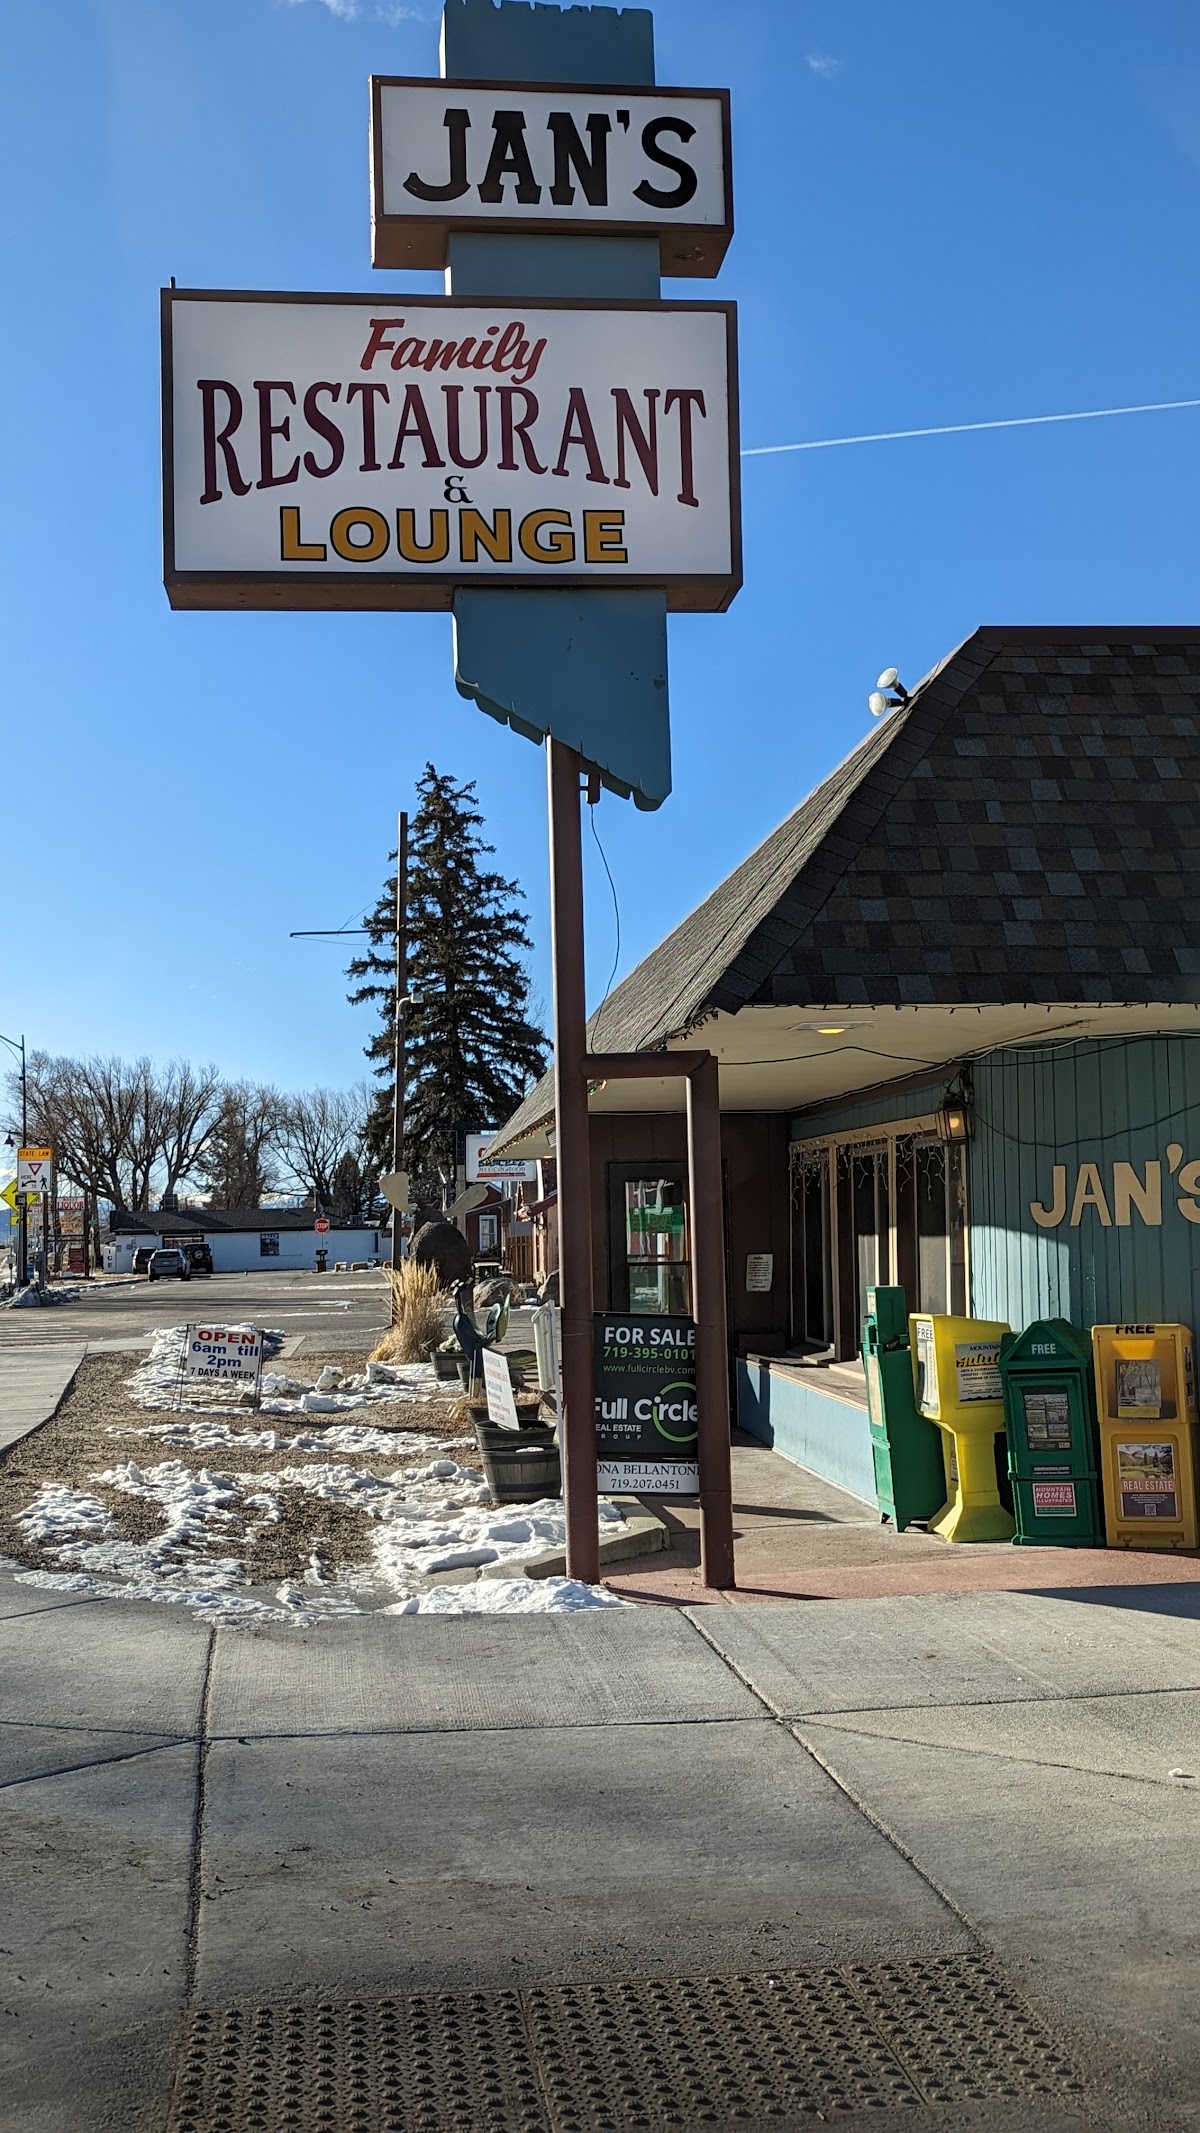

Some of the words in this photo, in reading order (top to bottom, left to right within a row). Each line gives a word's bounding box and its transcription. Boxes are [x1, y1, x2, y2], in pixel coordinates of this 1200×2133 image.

[403, 109, 698, 209] JAN'S
[359, 318, 548, 384] Family
[197, 380, 707, 508] RESTAURANT
[443, 475, 473, 504] &
[279, 506, 628, 564] LOUNGE
[57, 1201, 84, 1210] LIQUOR
[604, 1326, 645, 1345] FOR
[649, 1328, 696, 1346] SALE
[917, 1327, 934, 1340] FREE
[1115, 1325, 1155, 1335] FREE
[198, 1330, 256, 1345] OPEN
[192, 1341, 227, 1355] 6am
[237, 1345, 259, 1357] till
[603, 1346, 696, 1360] 719-395-0101
[1031, 1343, 1057, 1355] FREE
[207, 1354, 242, 1368] 2pm
[190, 1367, 196, 1375] 7
[198, 1367, 220, 1377] DAYS
[222, 1369, 228, 1378] A
[230, 1370, 256, 1380] WEEK
[603, 1363, 697, 1375] www.fullcirclebv.com
[634, 1395, 698, 1422] Circle
[595, 1423, 612, 1432] EAL
[612, 1423, 642, 1433] ESTATE
[610, 1478, 680, 1490] 719.207.0451
[1123, 1481, 1144, 1491] REAL
[1145, 1480, 1173, 1490] ESTATE
